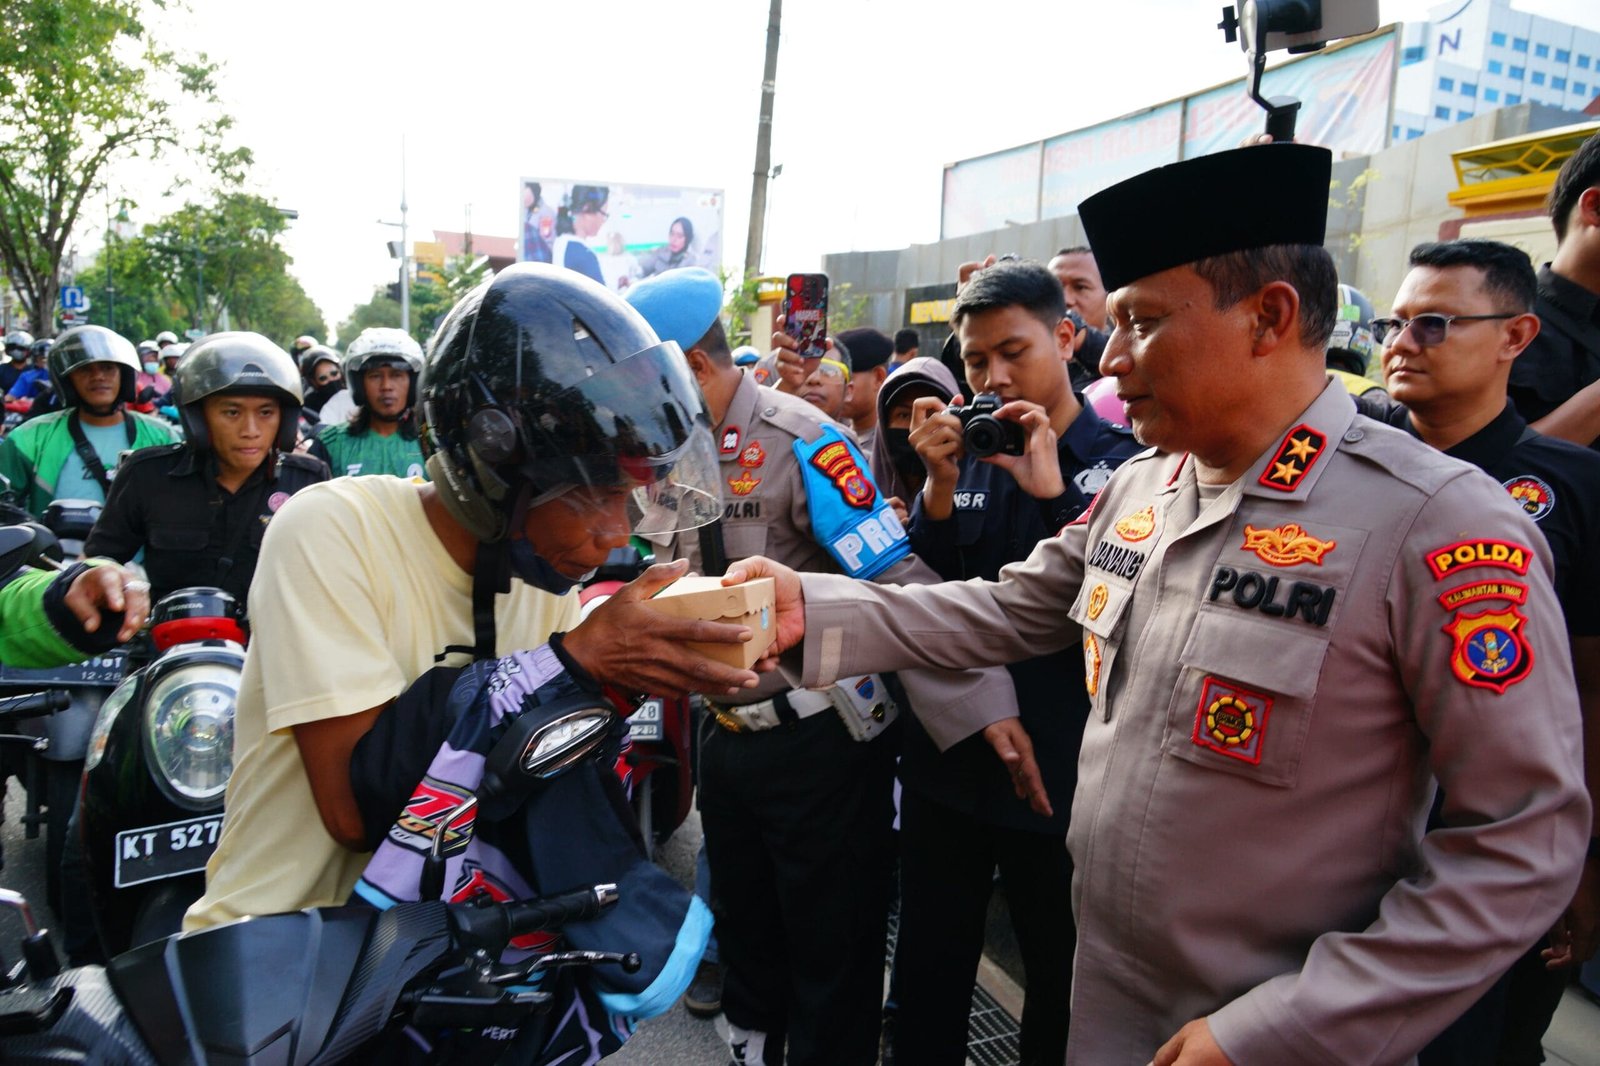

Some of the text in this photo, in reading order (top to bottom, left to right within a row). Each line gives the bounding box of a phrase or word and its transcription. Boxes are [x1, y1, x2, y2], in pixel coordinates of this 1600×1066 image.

[1439, 28, 1461, 55] N
[972, 492, 986, 508] R
[1089, 541, 1145, 581] NANANG
[1434, 543, 1523, 571] POLDA
[1211, 566, 1336, 627] POLRI
[1447, 584, 1522, 604] KALIMANTAN TIMUR
[123, 820, 224, 860] KT 527
